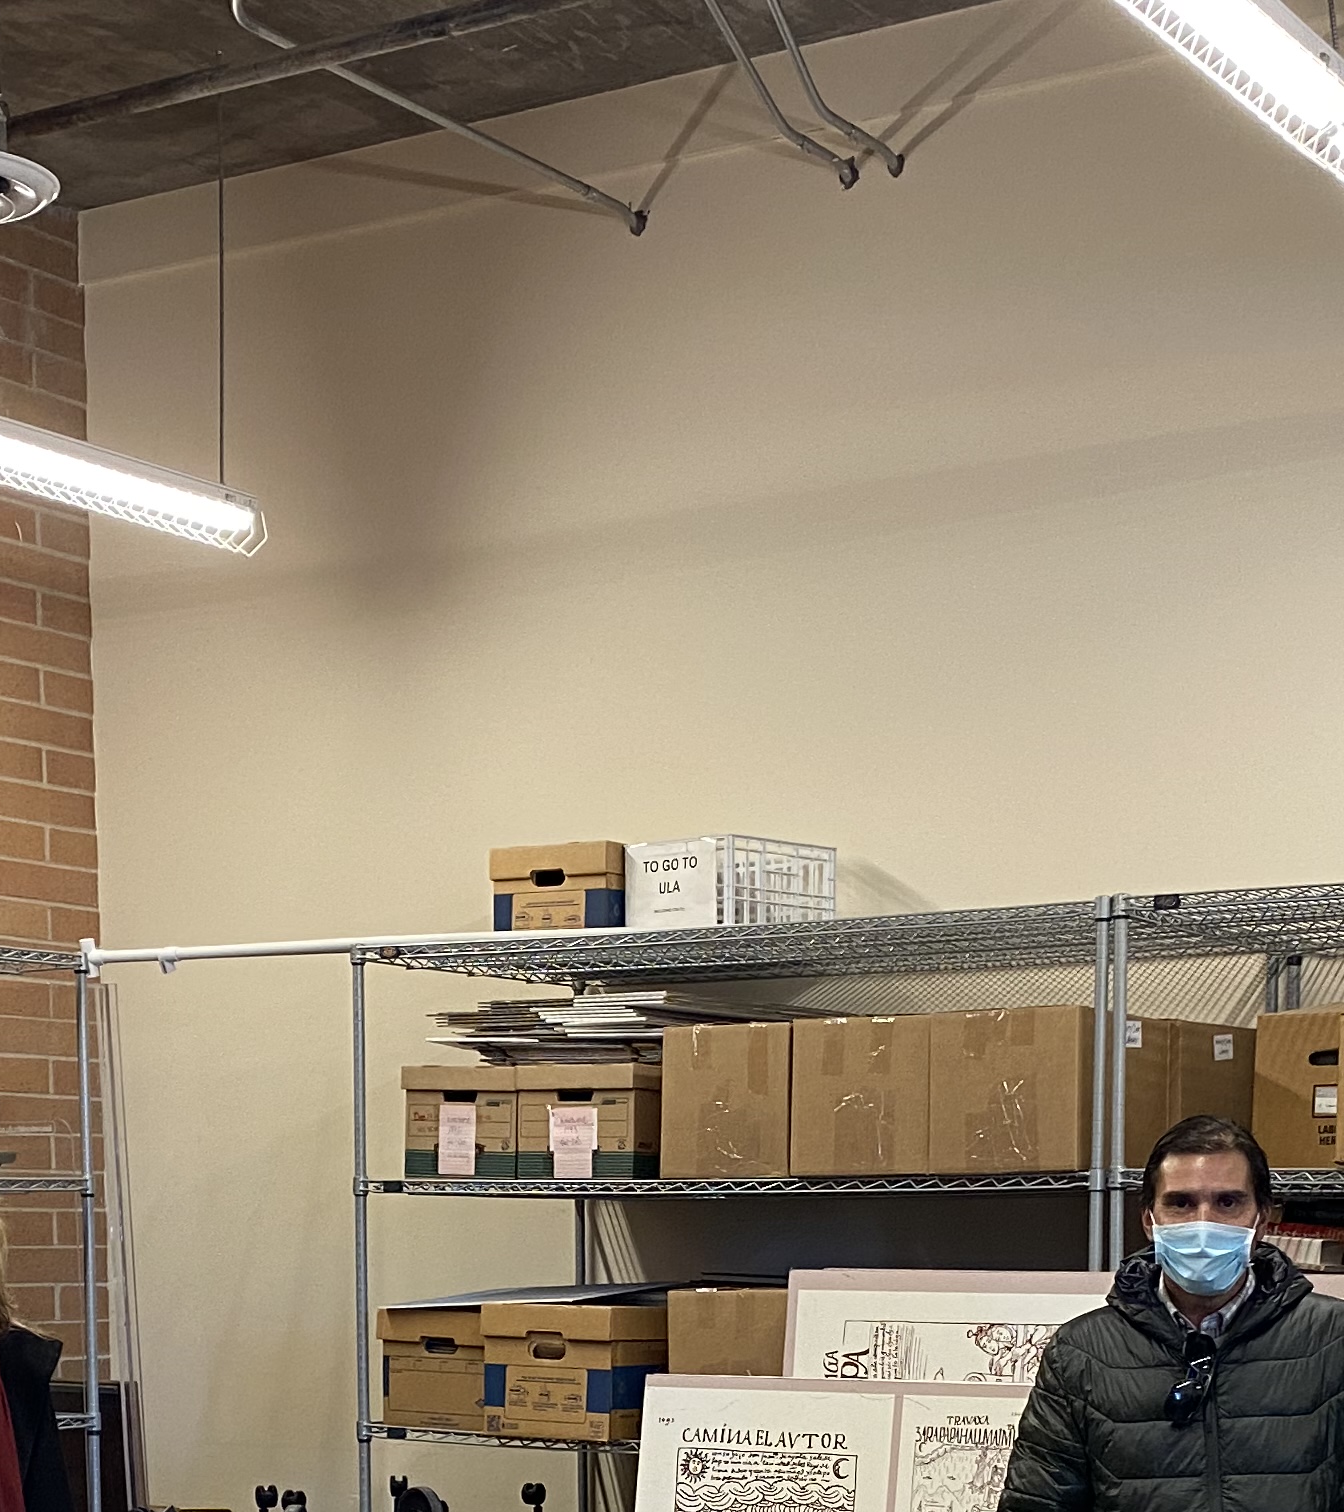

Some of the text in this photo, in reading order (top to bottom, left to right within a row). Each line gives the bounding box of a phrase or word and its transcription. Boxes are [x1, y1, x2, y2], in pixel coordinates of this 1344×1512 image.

[643, 856, 698, 874] TO GO TO
[659, 880, 681, 895] ULA
